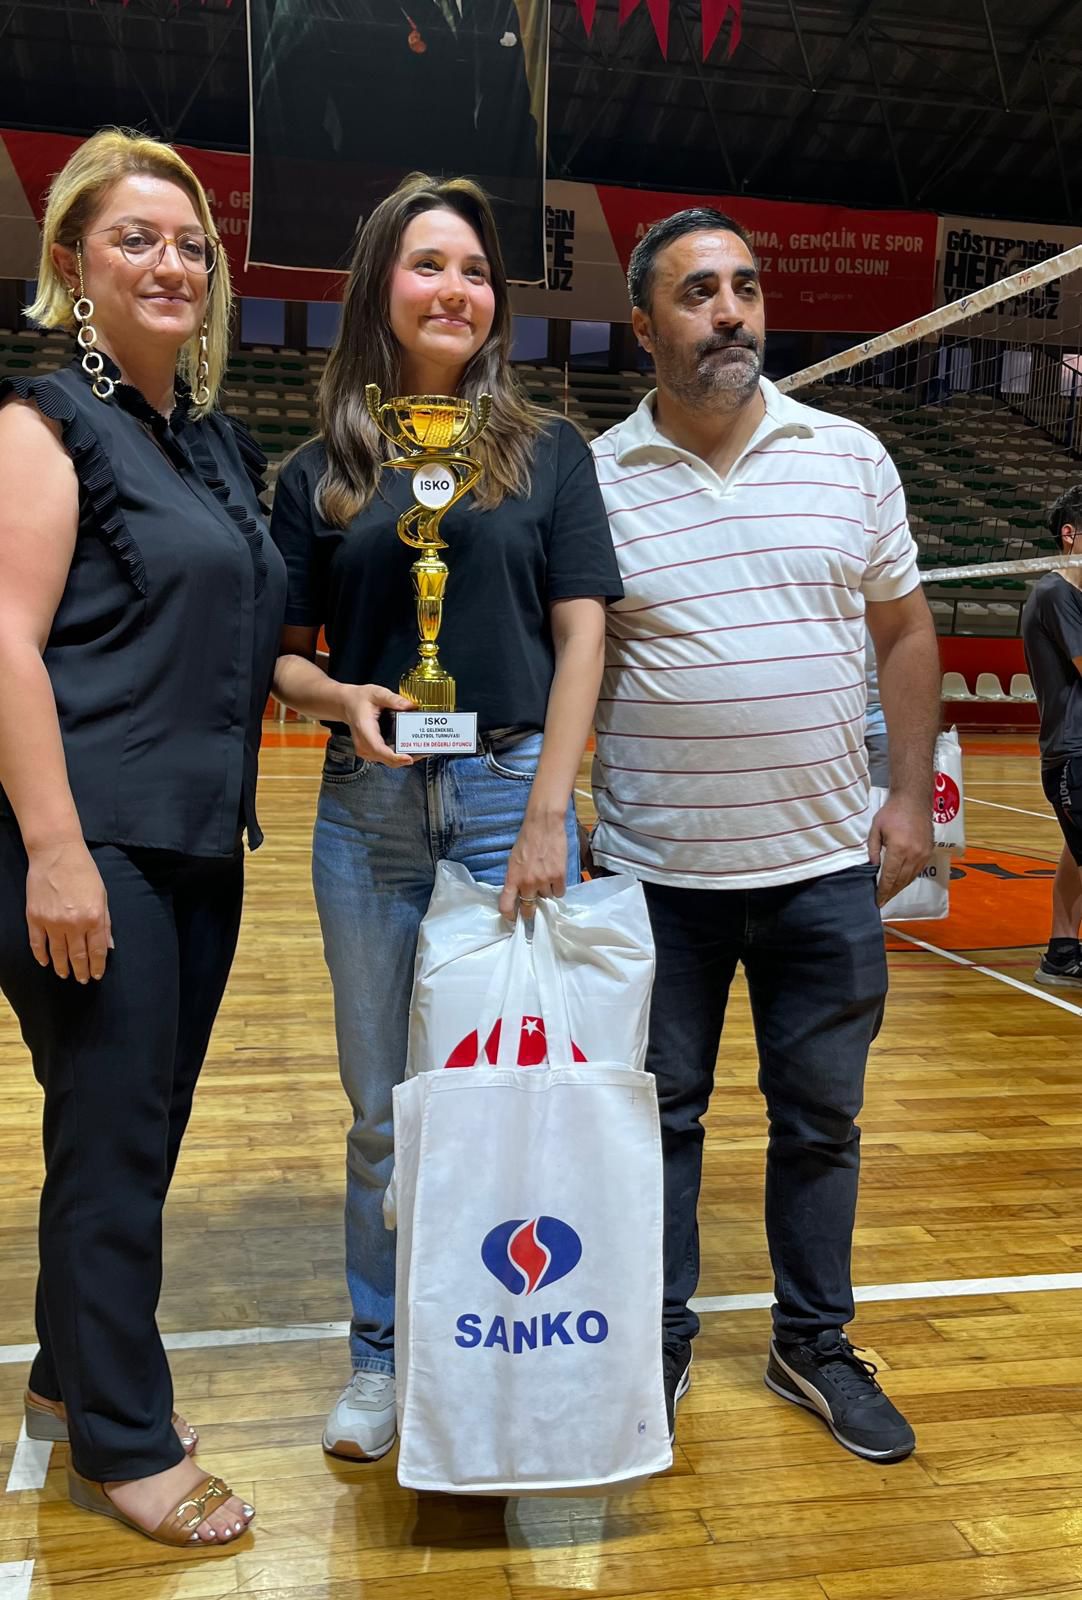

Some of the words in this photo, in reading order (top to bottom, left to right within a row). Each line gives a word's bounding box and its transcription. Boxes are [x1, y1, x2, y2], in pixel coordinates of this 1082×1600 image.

[789, 226, 855, 252] GENÇLİK
[861, 233, 880, 251] VE
[884, 234, 923, 253] SPOR
[777, 257, 829, 273] KUTLU
[834, 257, 889, 276] OLSUN!
[420, 480, 450, 491] ISKO
[424, 717, 448, 725] ISKO
[454, 1309, 609, 1354] SANKO
